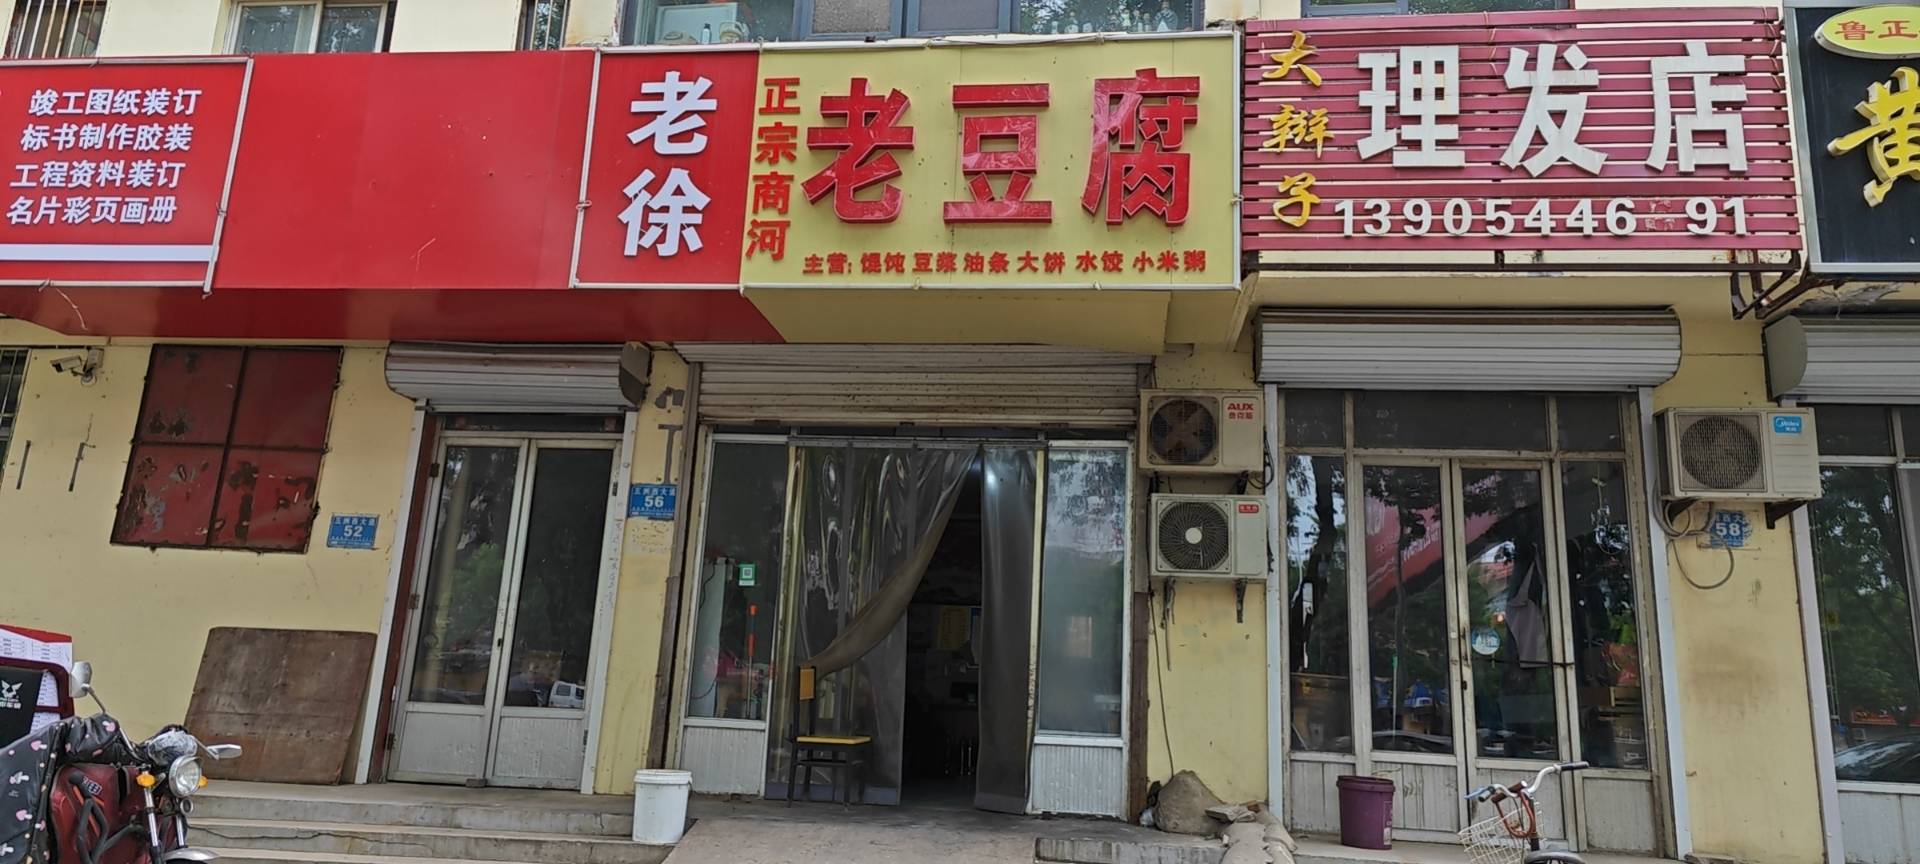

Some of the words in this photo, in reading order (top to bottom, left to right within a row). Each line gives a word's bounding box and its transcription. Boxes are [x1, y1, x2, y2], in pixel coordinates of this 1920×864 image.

[28, 87, 203, 116] 竣工图纸装订
[1356, 41, 1748, 178] 理发店
[20, 122, 194, 152] 标书制作胶装
[801, 68, 1200, 227] 老豆腐
[9, 159, 187, 189] 工程资料装订
[617, 71, 718, 257] 老徐
[745, 77, 800, 260] 正宗商河
[6, 195, 177, 225] 名片彩页画册
[1333, 197, 1637, 238] 13905446
[1684, 196, 1748, 237] 91
[860, 252, 904, 274] 馄饨
[912, 252, 956, 274] 豆浆
[963, 252, 1009, 274] 油条
[1016, 252, 1066, 273] 大饼
[1075, 251, 1123, 273] 水饺
[1132, 250, 1206, 272] 小米粥
[1227, 403, 1254, 411] AUX
[644, 496, 665, 508] 56
[343, 525, 363, 537] 52
[1715, 523, 1741, 537] 58
